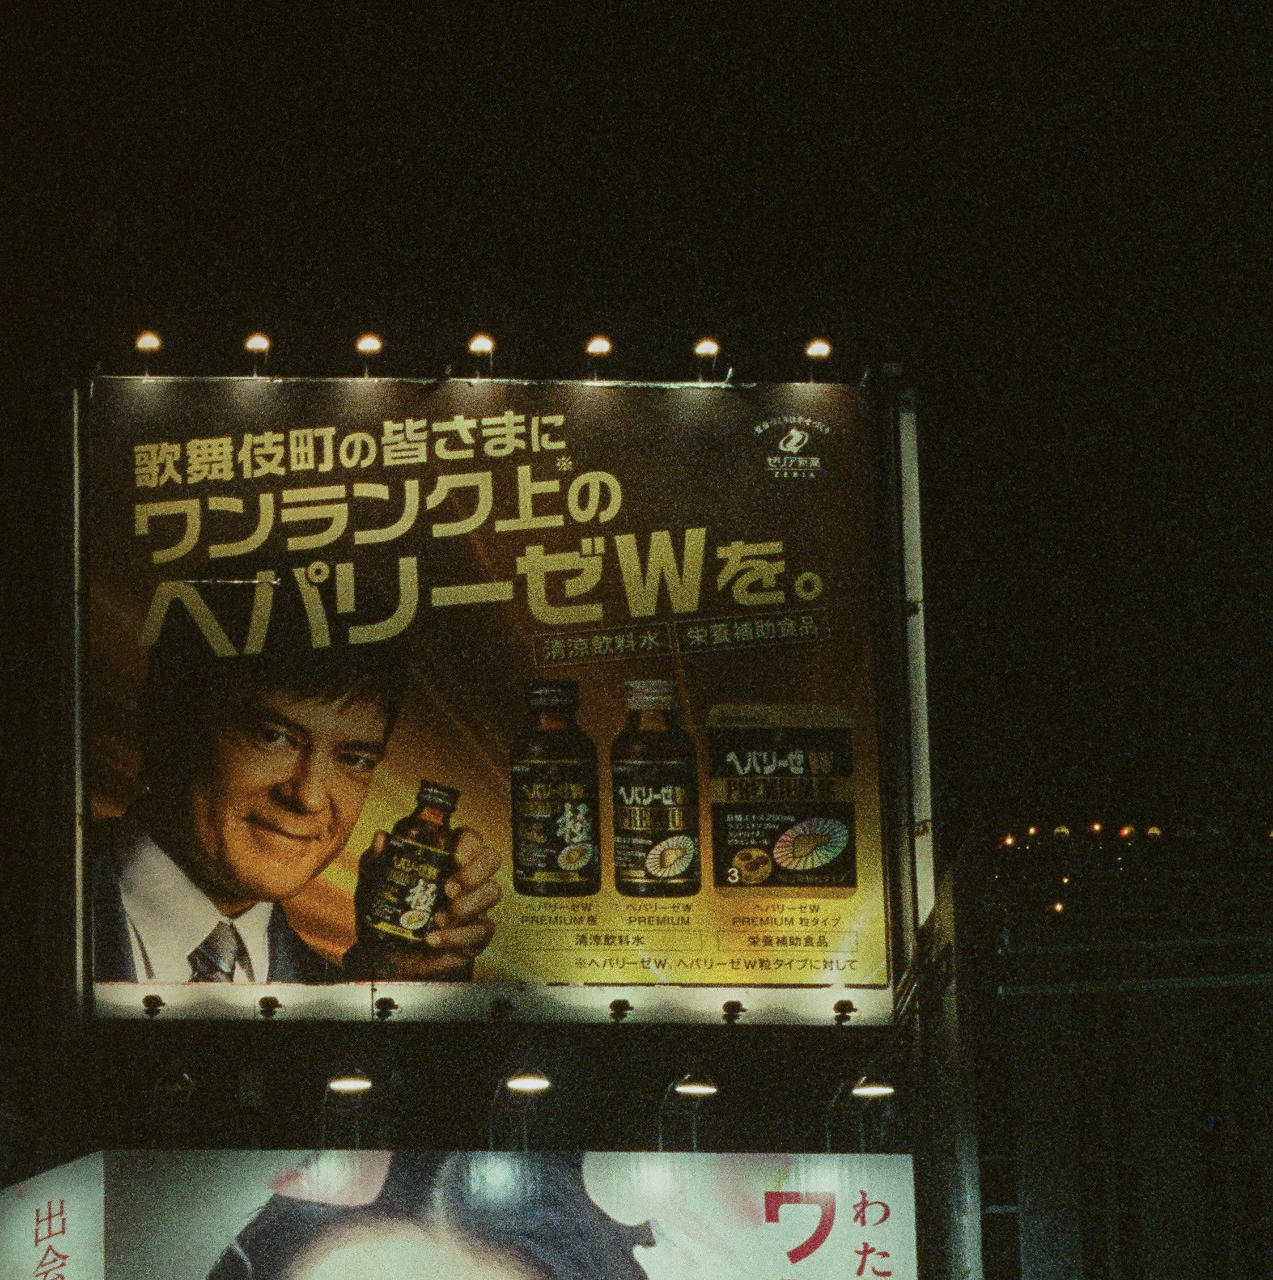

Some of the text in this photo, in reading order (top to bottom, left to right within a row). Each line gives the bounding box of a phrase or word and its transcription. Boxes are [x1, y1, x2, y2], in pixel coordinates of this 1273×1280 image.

[133, 410, 567, 488] 歌舞伎町の皆さまに
[138, 527, 823, 657] ヘパリーゼWを。
[628, 916, 691, 926] PREMIUM
